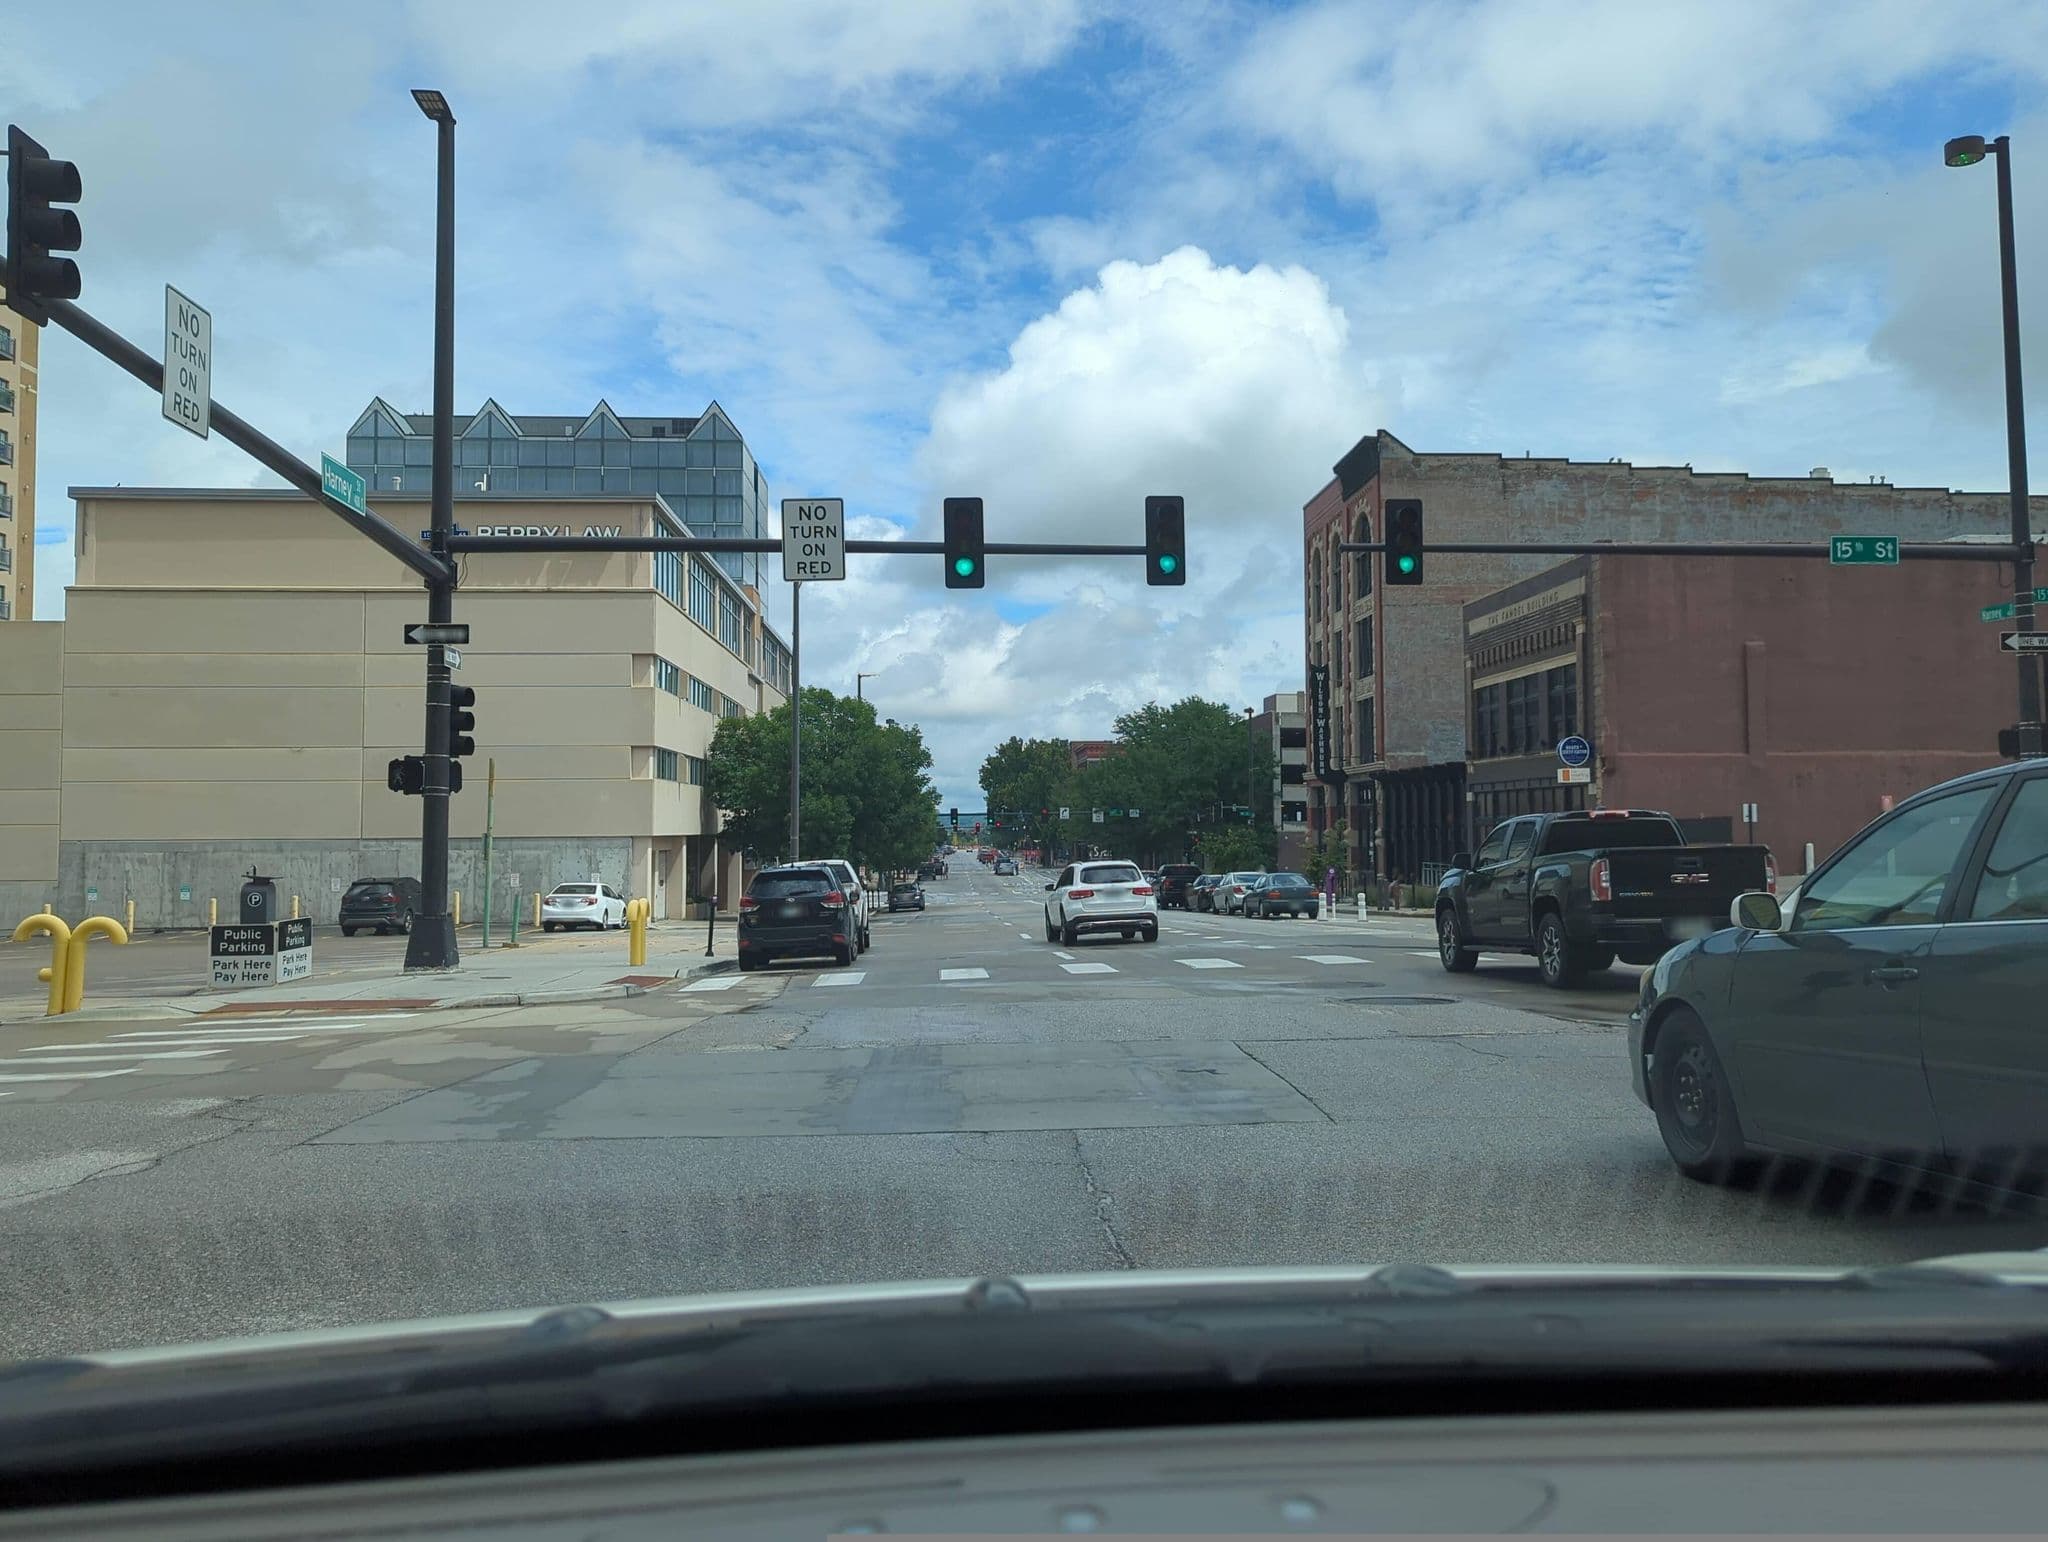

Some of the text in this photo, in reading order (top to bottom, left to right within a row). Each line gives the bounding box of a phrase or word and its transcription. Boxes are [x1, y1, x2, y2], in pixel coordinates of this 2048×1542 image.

[178, 303, 200, 338] NO
[171, 331, 206, 372] TURN
[179, 367, 198, 394] ON
[173, 391, 200, 423] RED
[324, 463, 353, 504] Harney
[799, 505, 827, 521] NO
[790, 526, 837, 539] TURN
[802, 543, 826, 556] ON
[1836, 541, 1894, 558] 15th St
[797, 561, 832, 574] RED
[1670, 873, 1710, 884] GMC
[224, 929, 262, 940] Public
[287, 923, 304, 934] Public
[285, 935, 305, 947] Parking
[219, 942, 266, 954] Parking
[212, 960, 272, 970] Park Here
[282, 952, 307, 965] Park Here
[214, 971, 269, 983] Pay Here
[283, 965, 306, 977] Pay Here
